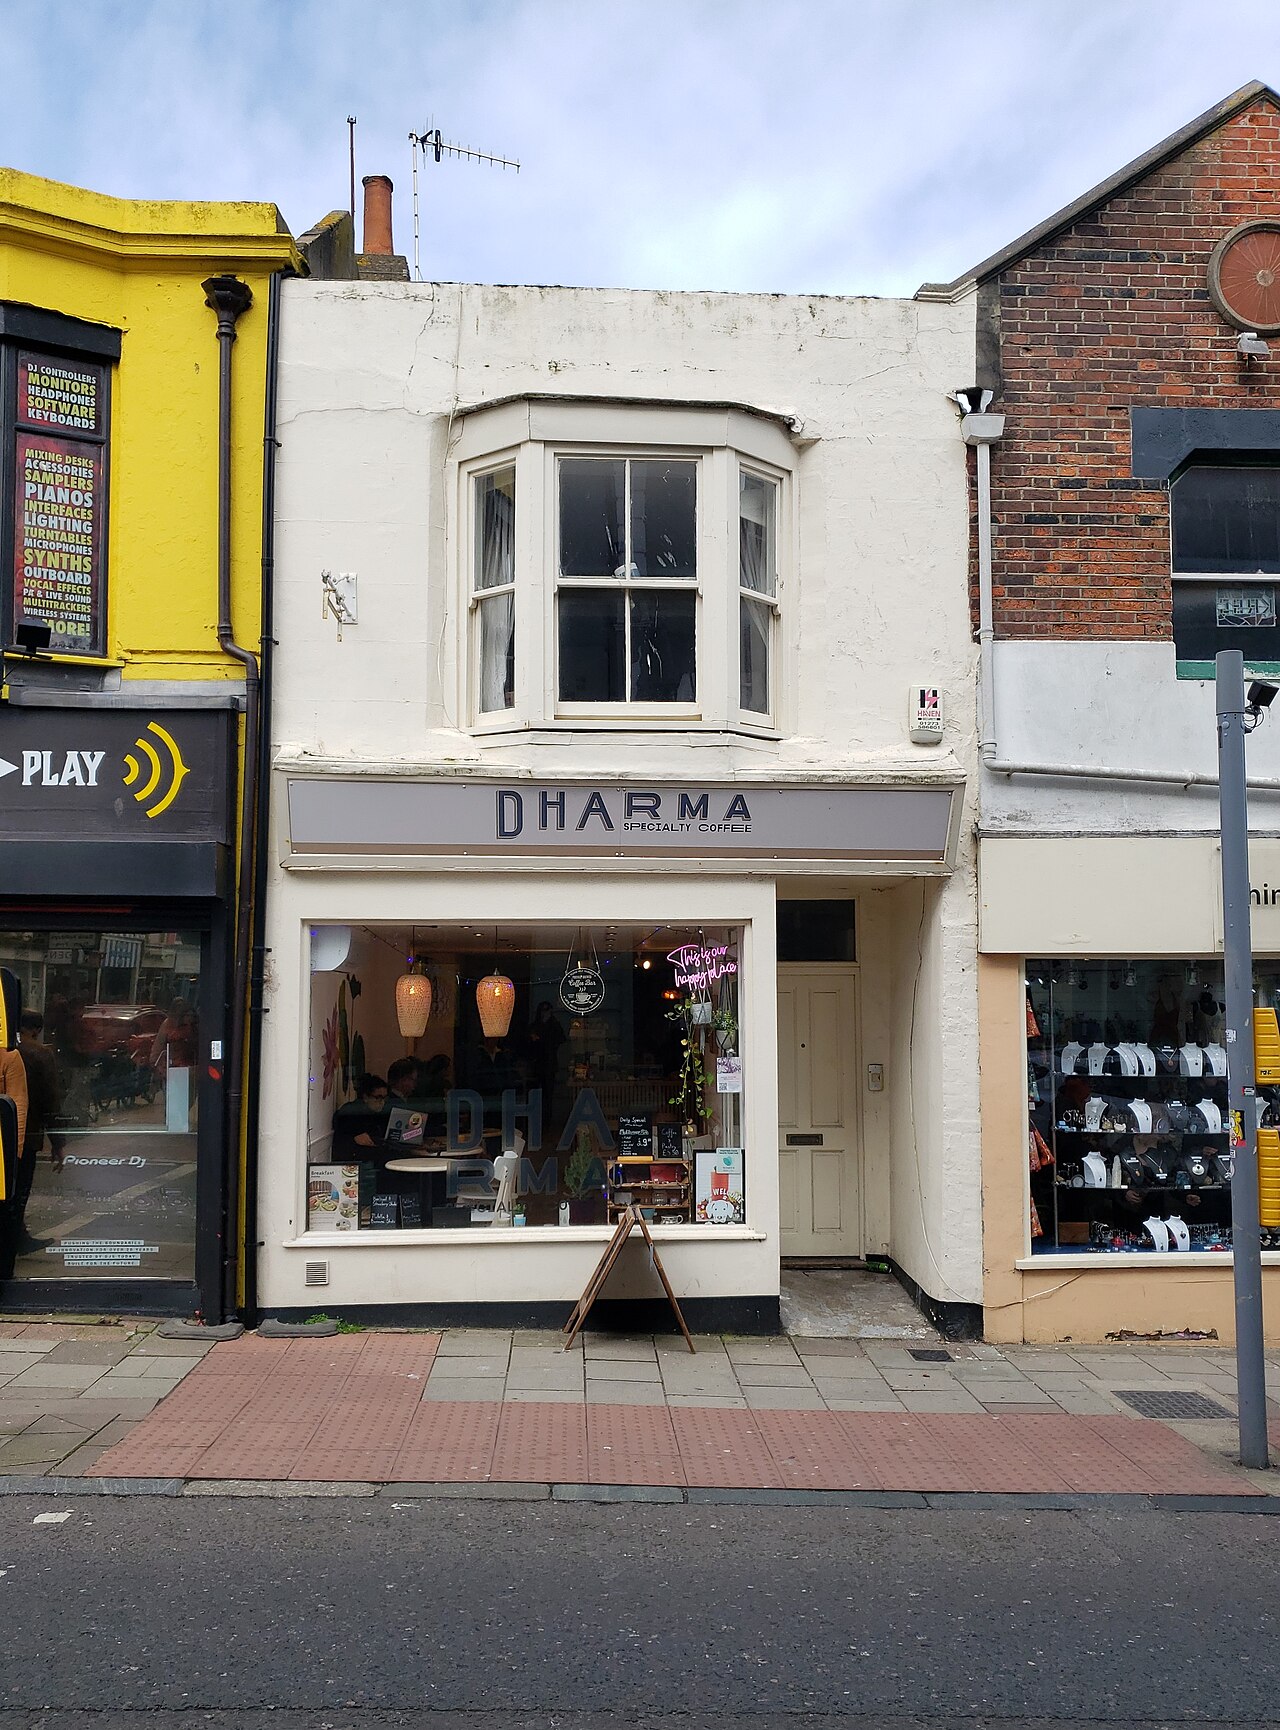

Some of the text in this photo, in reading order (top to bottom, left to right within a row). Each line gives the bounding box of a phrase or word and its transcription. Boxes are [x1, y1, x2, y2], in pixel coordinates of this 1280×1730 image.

[28, 363, 96, 384] DJ CONTROLLERS
[28, 372, 96, 396] MONITORS
[28, 385, 96, 406] HEADPHONES
[28, 396, 96, 419] SOFTWARE
[28, 408, 96, 430] KEYBOARDS
[25, 448, 94, 468] MIXING DESKS
[25, 459, 94, 479] ACCESSORIES
[25, 468, 94, 491] SAMPLERS
[25, 482, 93, 508] PIANOS
[25, 500, 93, 520] INTERFACES
[24, 512, 92, 534] LIGHTING
[24, 526, 92, 546] TURNTABLES
[24, 538, 92, 555] MICROPHONES
[24, 548, 92, 573] SYNTHS
[24, 566, 92, 585] OUTBOARD
[23, 578, 91, 595] VOCAL EFFECTS
[36, 589, 42, 598] &
[46, 591, 62, 600] LIVE
[64, 594, 91, 604] SOUND
[23, 597, 91, 613] MULTITRACKERS
[23, 607, 91, 622] WIRELESS SYSTEMS
[22, 750, 106, 786] PLAY
[496, 790, 752, 839] DHARMA
[623, 822, 752, 833] SPECIALTY COFFEE
[666, 944, 728, 972] This is our
[674, 959, 737, 990] happy place
[62, 1155, 125, 1165] Pioneer
